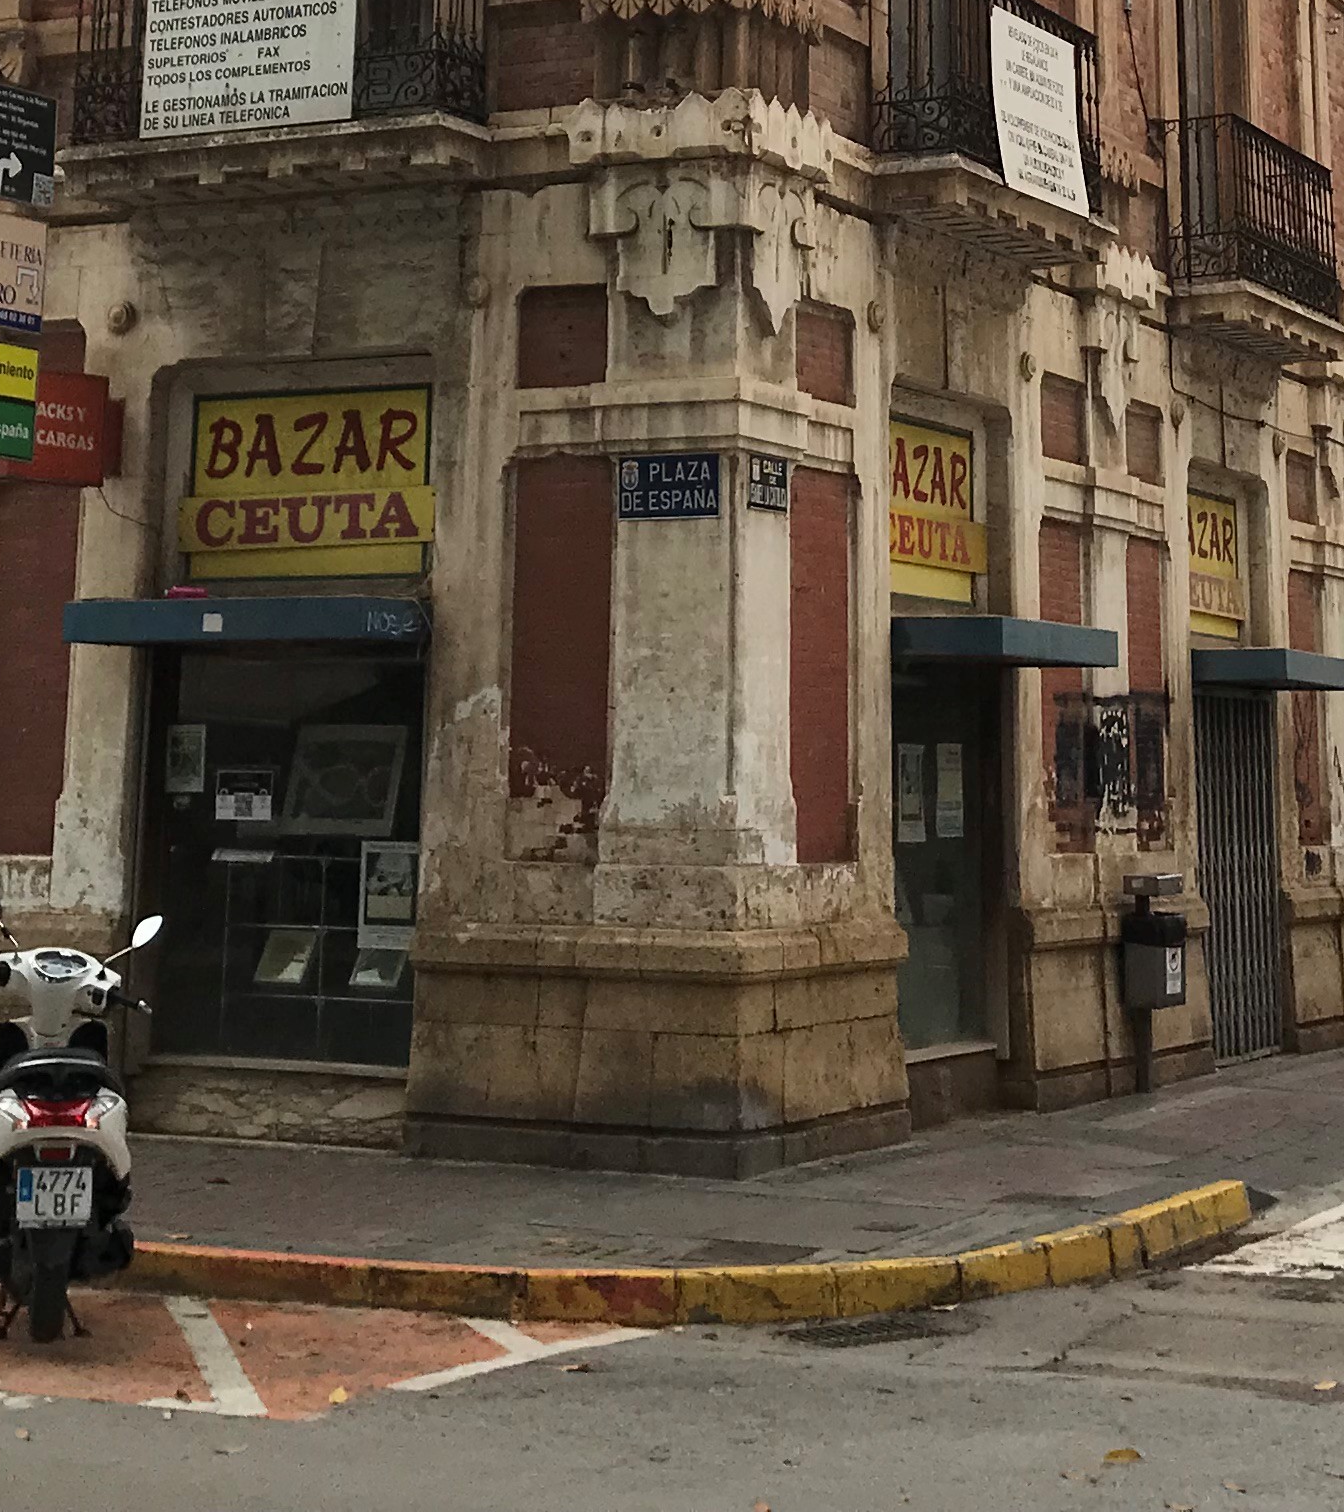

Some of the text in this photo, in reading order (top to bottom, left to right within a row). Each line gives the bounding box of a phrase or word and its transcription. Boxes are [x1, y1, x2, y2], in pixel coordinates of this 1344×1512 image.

[149, 0, 337, 34] CONTESTADORES AUTOMATICOS
[149, 24, 307, 52] TELEFONOS INALAMBRICOS
[147, 45, 280, 70] SUPLETORIOS FAX
[147, 59, 311, 86] TODOS LOS COMPLEMENTOS
[145, 81, 348, 114] LE GESTIONAMOS LA TRAMITACION
[143, 105, 290, 131] DE SU LINEA TELEFONICA
[204, 407, 418, 480] BAZAR
[649, 461, 711, 483] PLAZA
[762, 459, 783, 476] CALLE
[889, 437, 967, 510] AZAR
[621, 484, 718, 512] DE ESPAÑA
[195, 491, 420, 547] CEUTA
[36, 1170, 86, 1192] 4774
